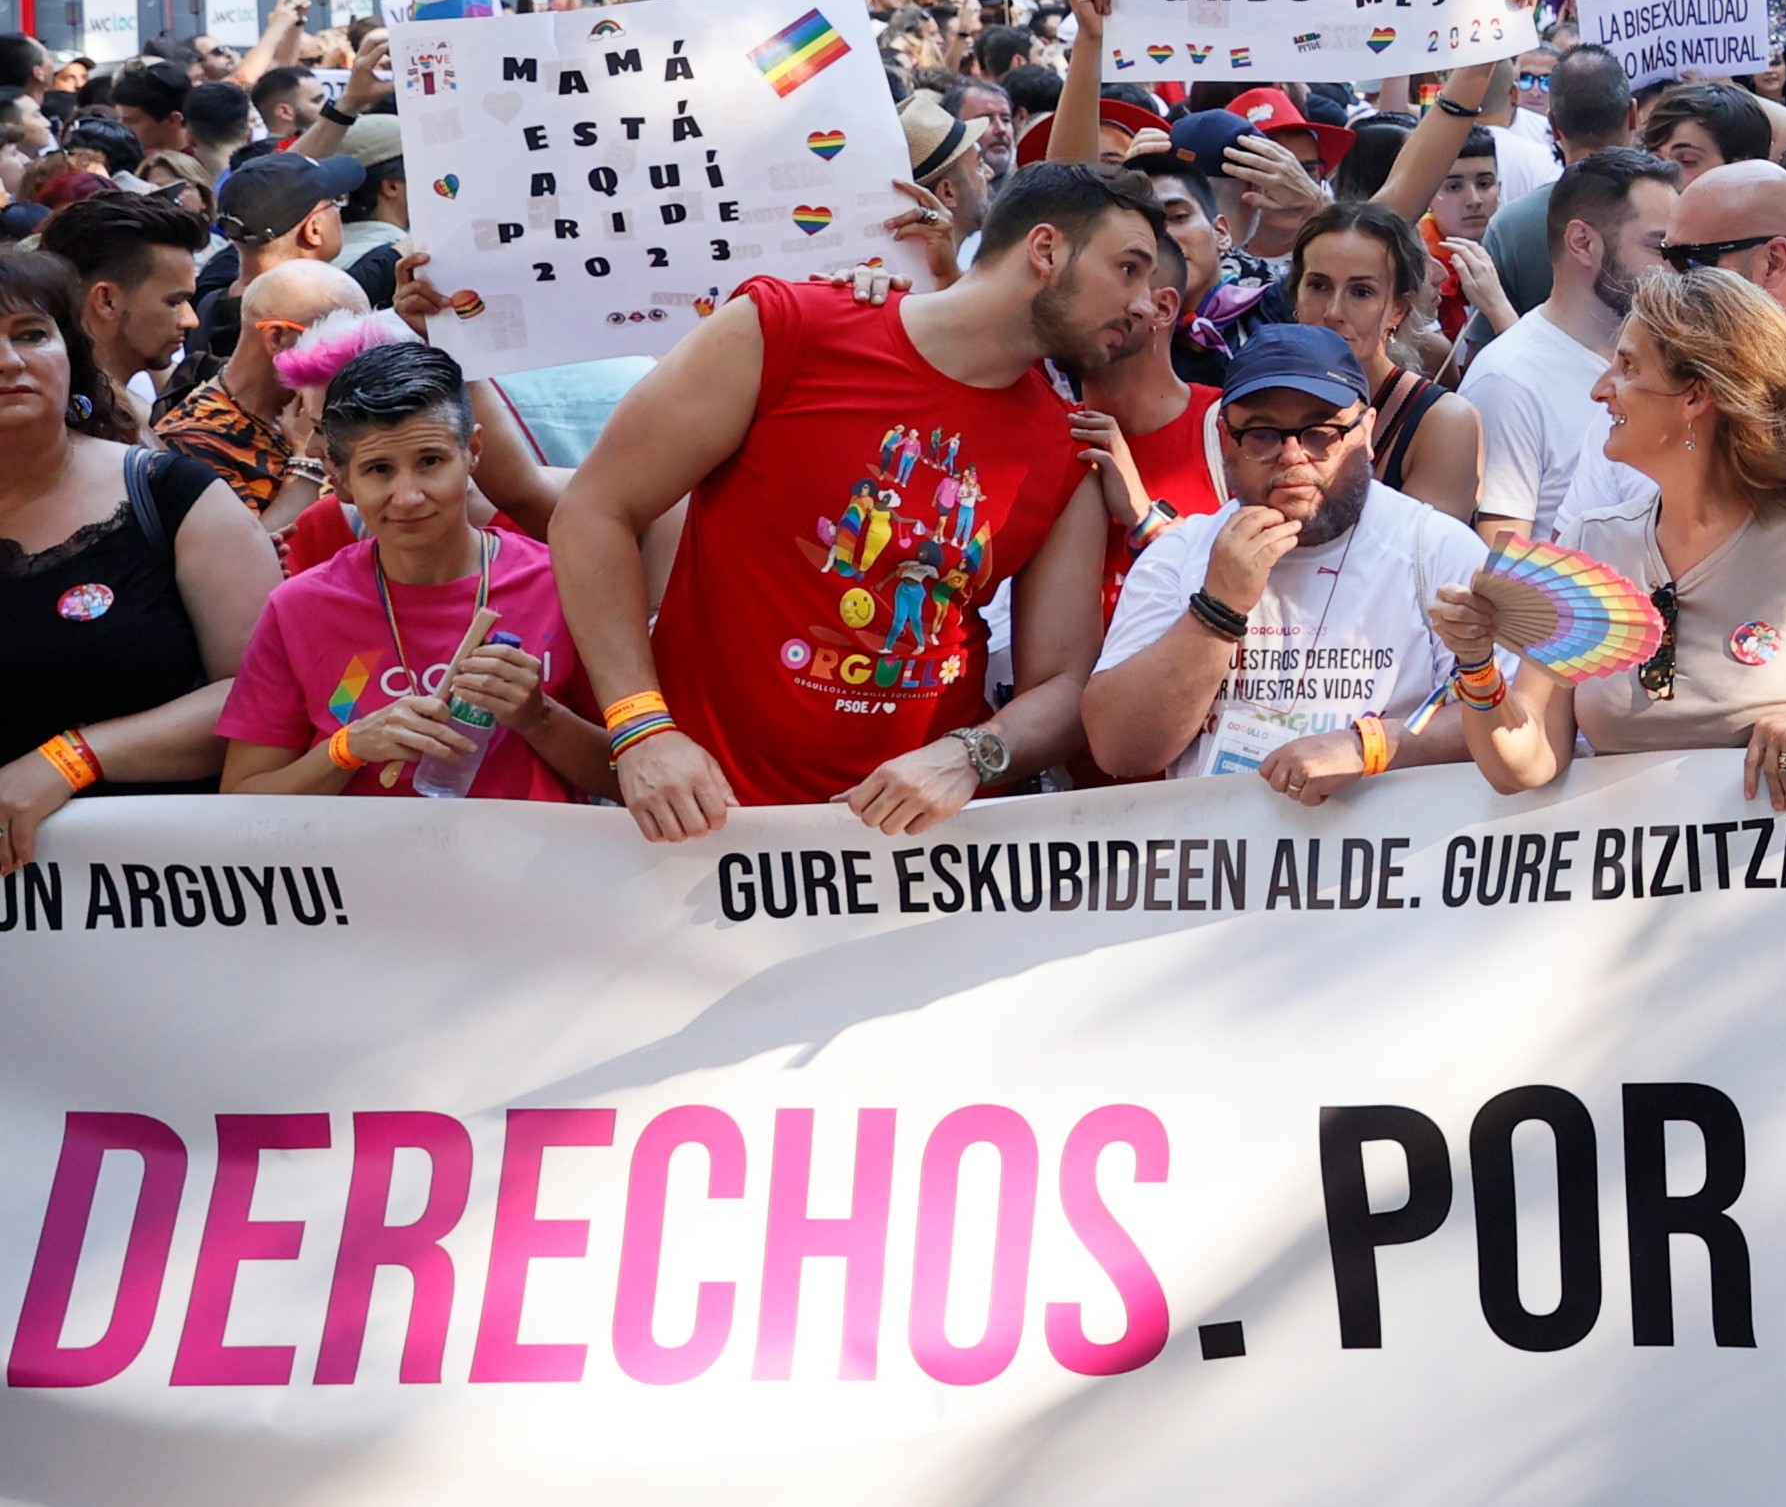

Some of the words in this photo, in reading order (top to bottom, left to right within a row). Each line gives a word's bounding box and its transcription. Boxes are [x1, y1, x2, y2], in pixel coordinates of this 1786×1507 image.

[1427, 17, 1504, 53] 2023
[1599, 13, 1623, 45] LA
[503, 39, 695, 96] MAMÁ
[1641, 35, 1677, 75] MÁS
[1682, 35, 1766, 66] NATURAL.
[523, 99, 704, 152] ESTÁ
[530, 149, 725, 198] AQUÍ
[498, 200, 740, 244] PRIDE
[532, 238, 732, 282] 2023
[1250, 626, 1300, 637] ORGULLO
[1229, 648, 1300, 671] UESTROS
[1306, 647, 1394, 670] DERECHOS
[794, 676, 847, 696] ORGULLOSA
[851, 688, 887, 699] FAMILIA
[834, 698, 869, 714] PSOE
[1235, 677, 1317, 701] NUESTRAS
[1323, 677, 1375, 700] VIDAS
[1227, 721, 1269, 740] ORGULLO
[86, 863, 348, 929] ARGUYU!
[719, 851, 878, 921] GURE
[893, 840, 1246, 912] ESKUBIDEEN
[1266, 838, 1420, 909] ALDE.
[1443, 831, 1574, 907] GURE
[7, 1105, 1246, 1388] DERECHOS.
[1320, 1083, 1757, 1352] POR
